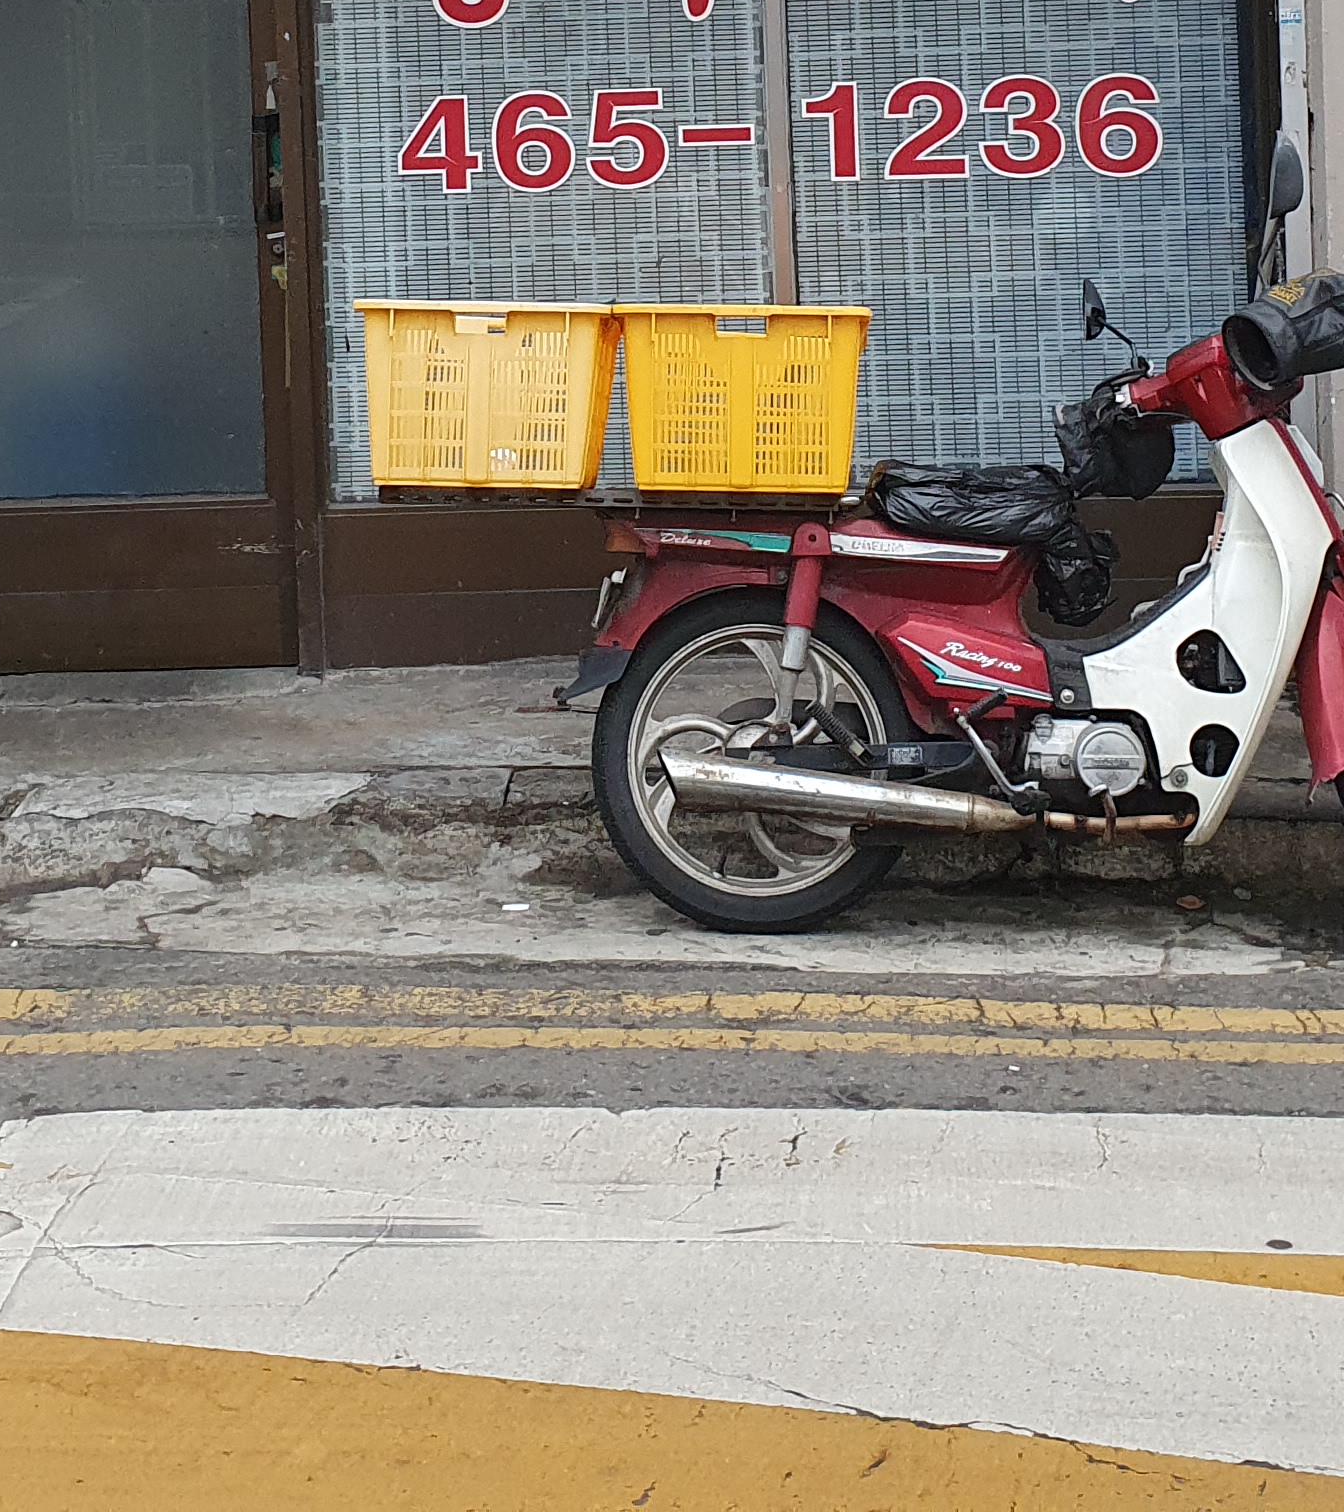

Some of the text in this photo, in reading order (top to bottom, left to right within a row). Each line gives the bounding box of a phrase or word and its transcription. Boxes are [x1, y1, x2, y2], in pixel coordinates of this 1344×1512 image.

[660, 531, 712, 546] Deluxe
[940, 641, 1023, 673] Racing 100
